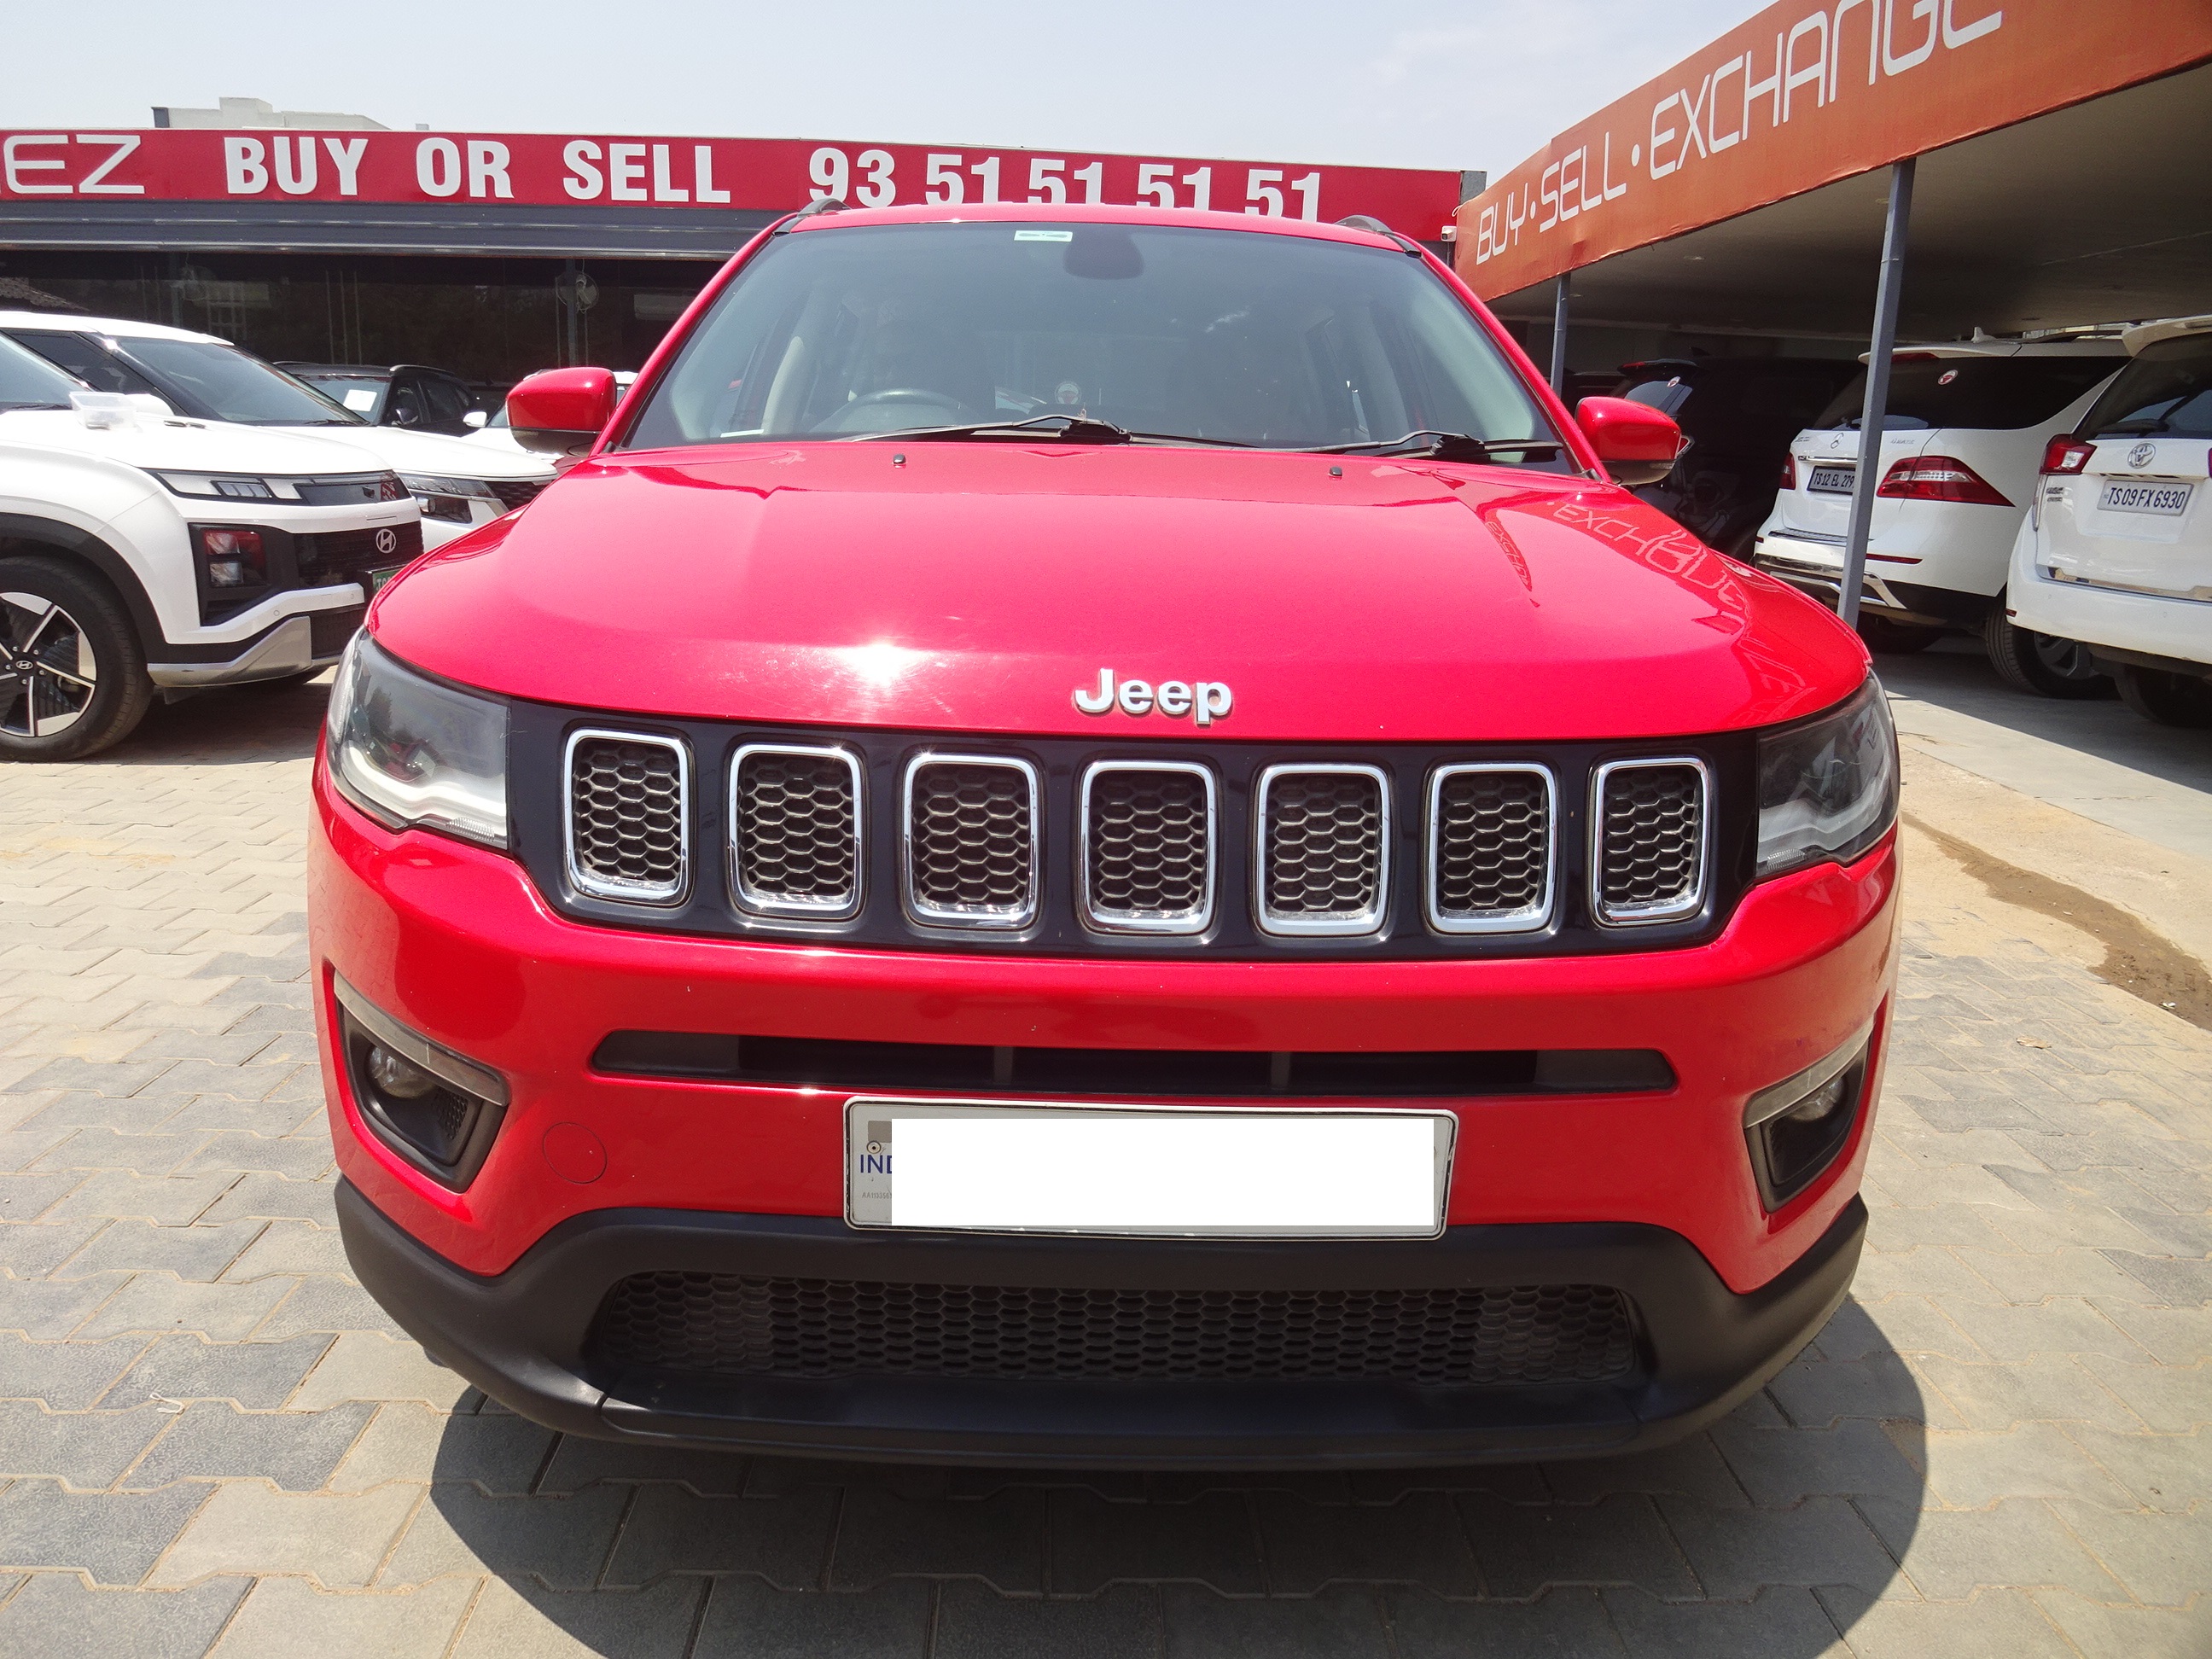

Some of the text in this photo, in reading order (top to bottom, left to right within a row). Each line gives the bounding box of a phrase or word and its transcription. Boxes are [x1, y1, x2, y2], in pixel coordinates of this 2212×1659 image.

[0, 134, 1321, 224] EZ BUY OR SELL 93 51 51 51 51
[1476, 182, 1529, 266] BUY
[1539, 131, 1627, 233] SELL
[1840, 474, 1855, 489] 279
[2107, 487, 2186, 509] TS09 FX 6930
[1074, 668, 1233, 727] Jeep
